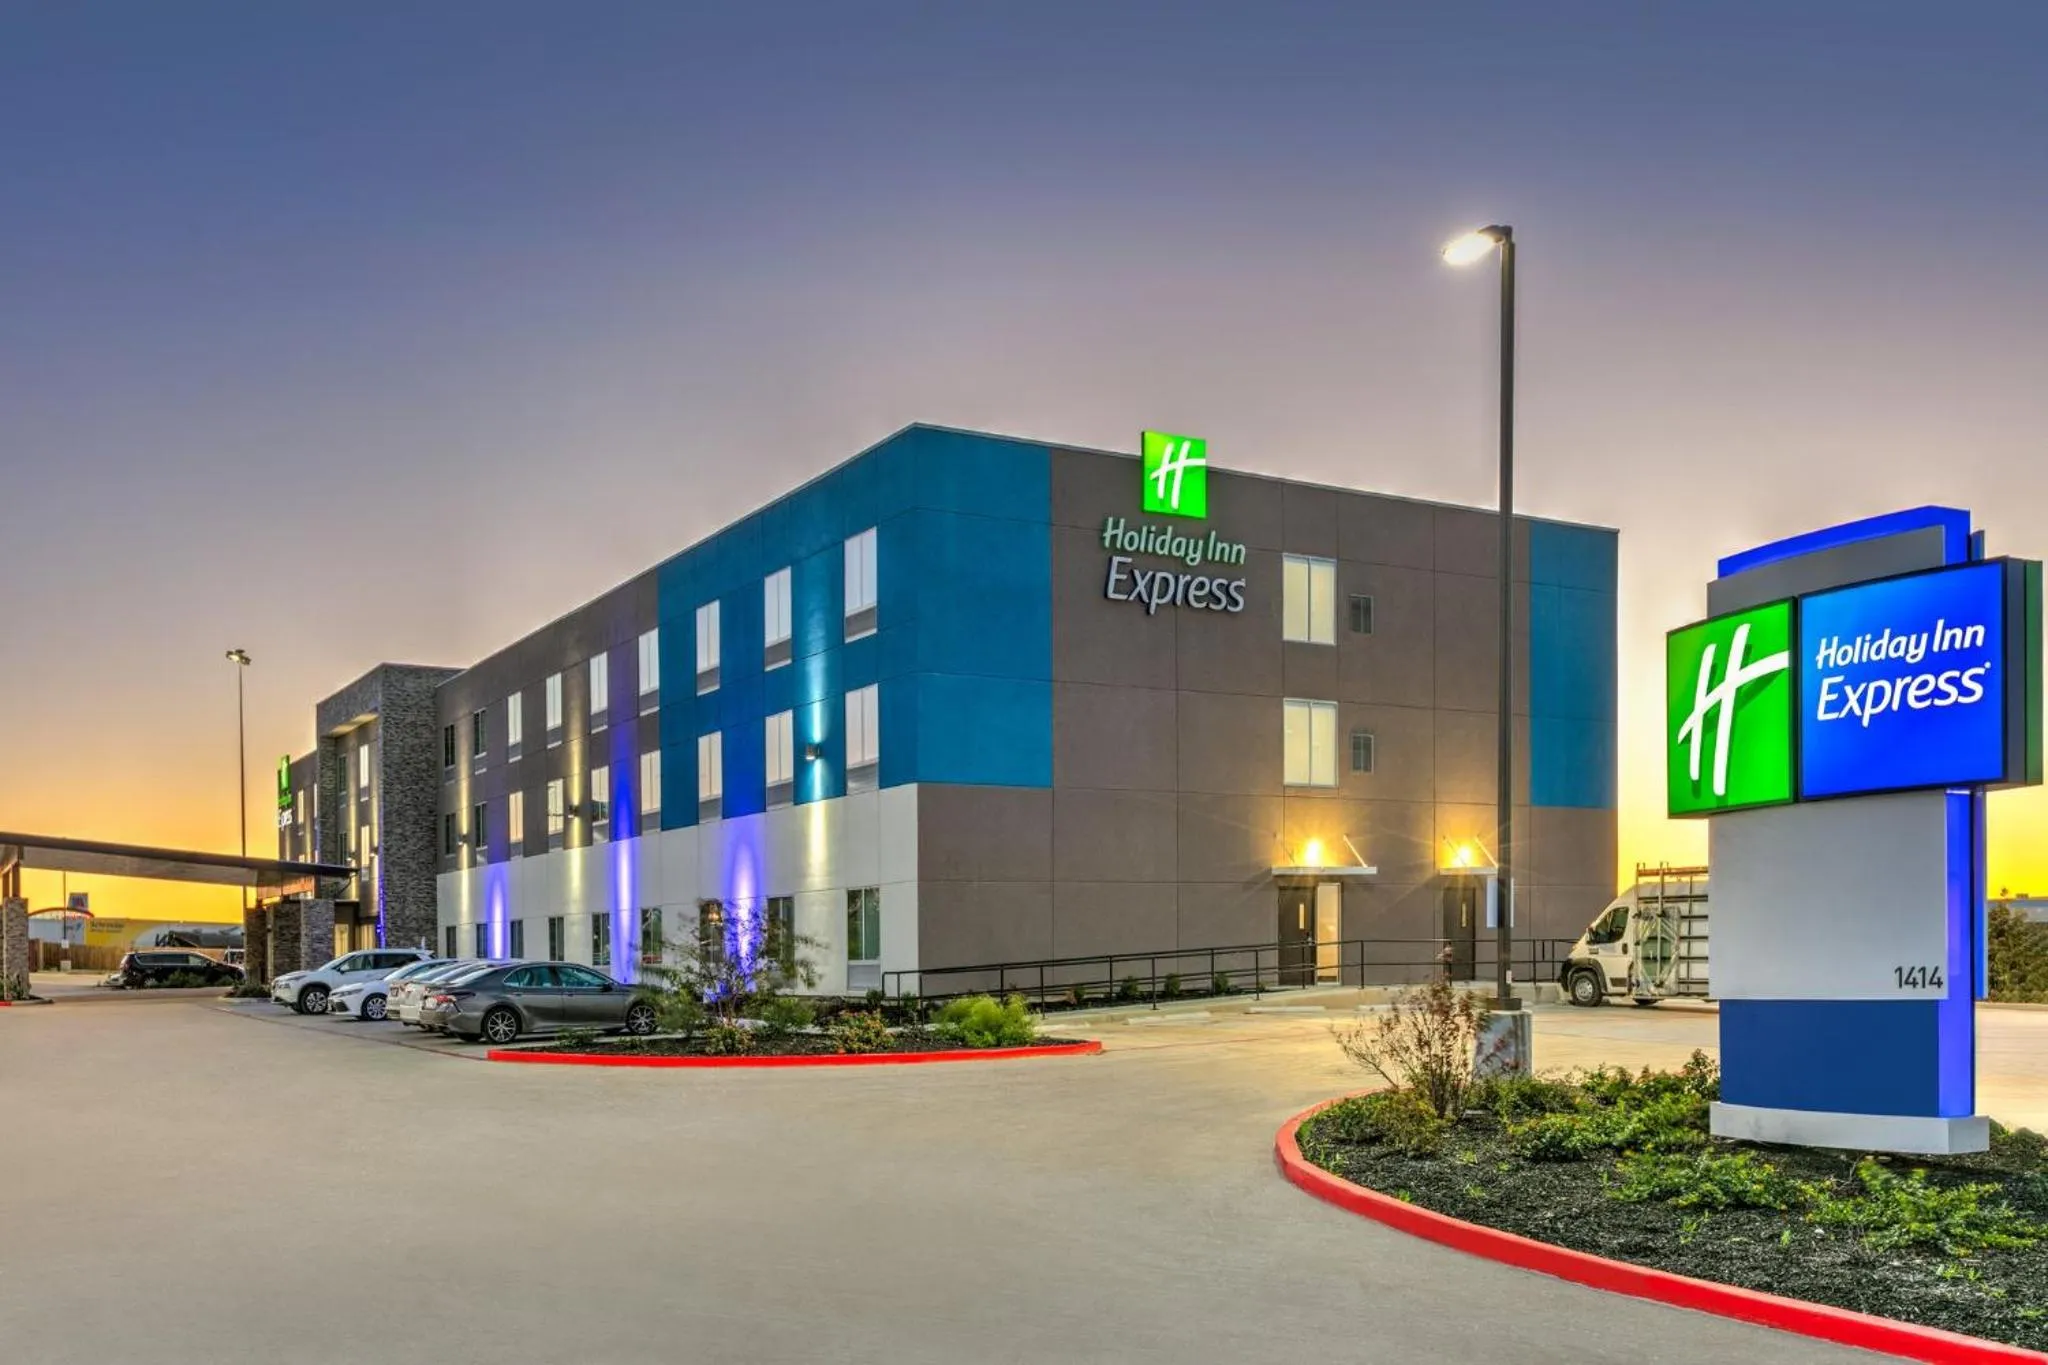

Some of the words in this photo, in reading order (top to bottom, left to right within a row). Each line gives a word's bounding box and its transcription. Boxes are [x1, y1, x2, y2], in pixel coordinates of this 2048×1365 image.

[1102, 516, 1204, 567] Holiday
[1207, 530, 1246, 565] Inn
[1105, 555, 1246, 615] Express
[1816, 628, 1928, 670] Holiday
[1932, 619, 1985, 653] Inn
[1816, 665, 1987, 728] Express
[1894, 966, 1944, 989] 1414
